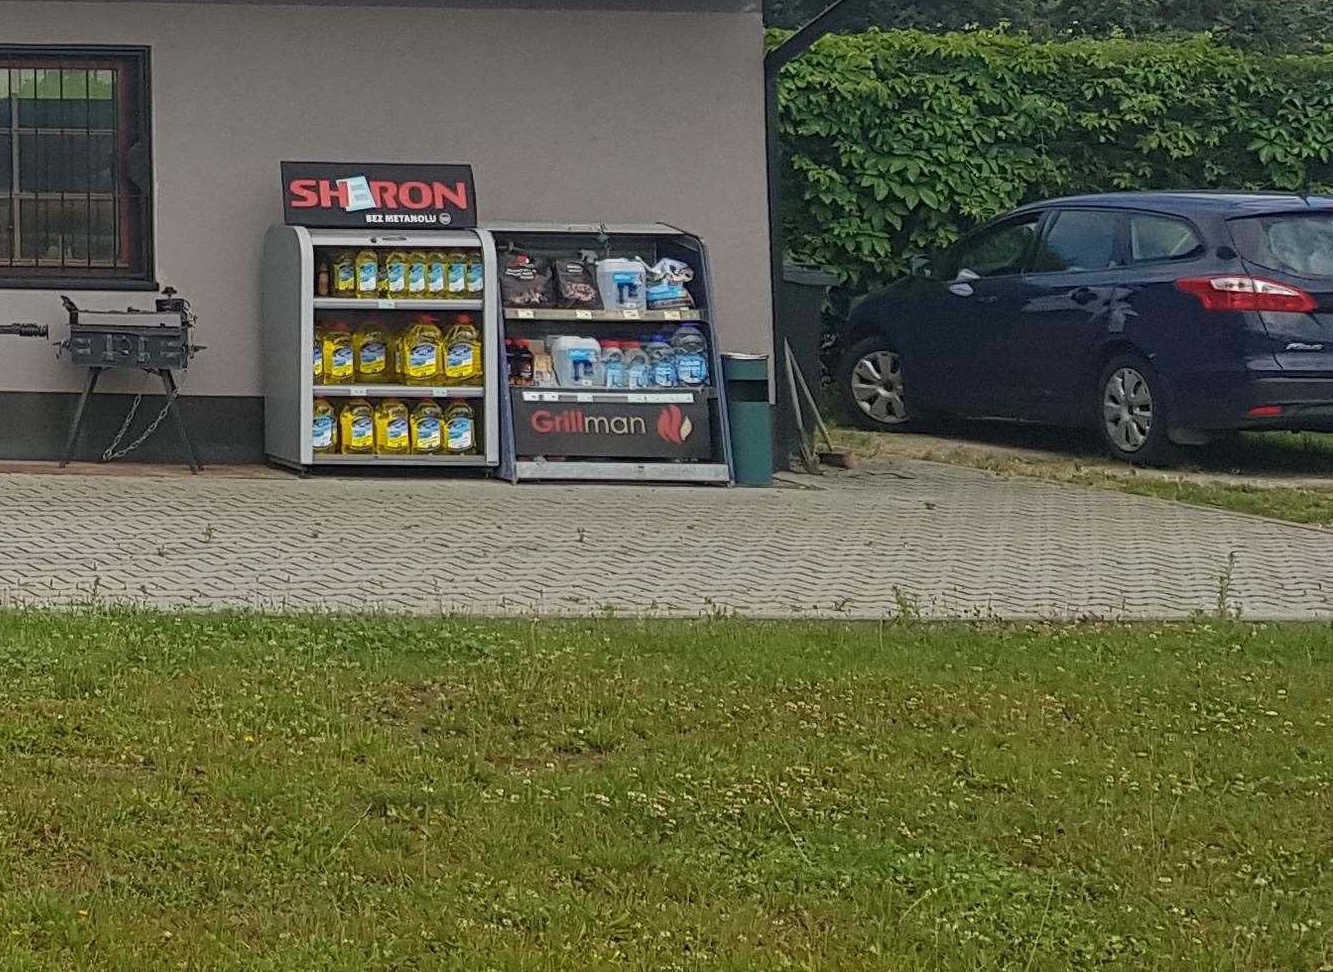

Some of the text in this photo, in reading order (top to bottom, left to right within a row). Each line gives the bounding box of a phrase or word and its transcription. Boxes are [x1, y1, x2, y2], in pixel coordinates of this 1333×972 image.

[289, 177, 469, 210] SHERON
[365, 214, 437, 223] BEZ METANOLU
[531, 409, 646, 435] Grillman
